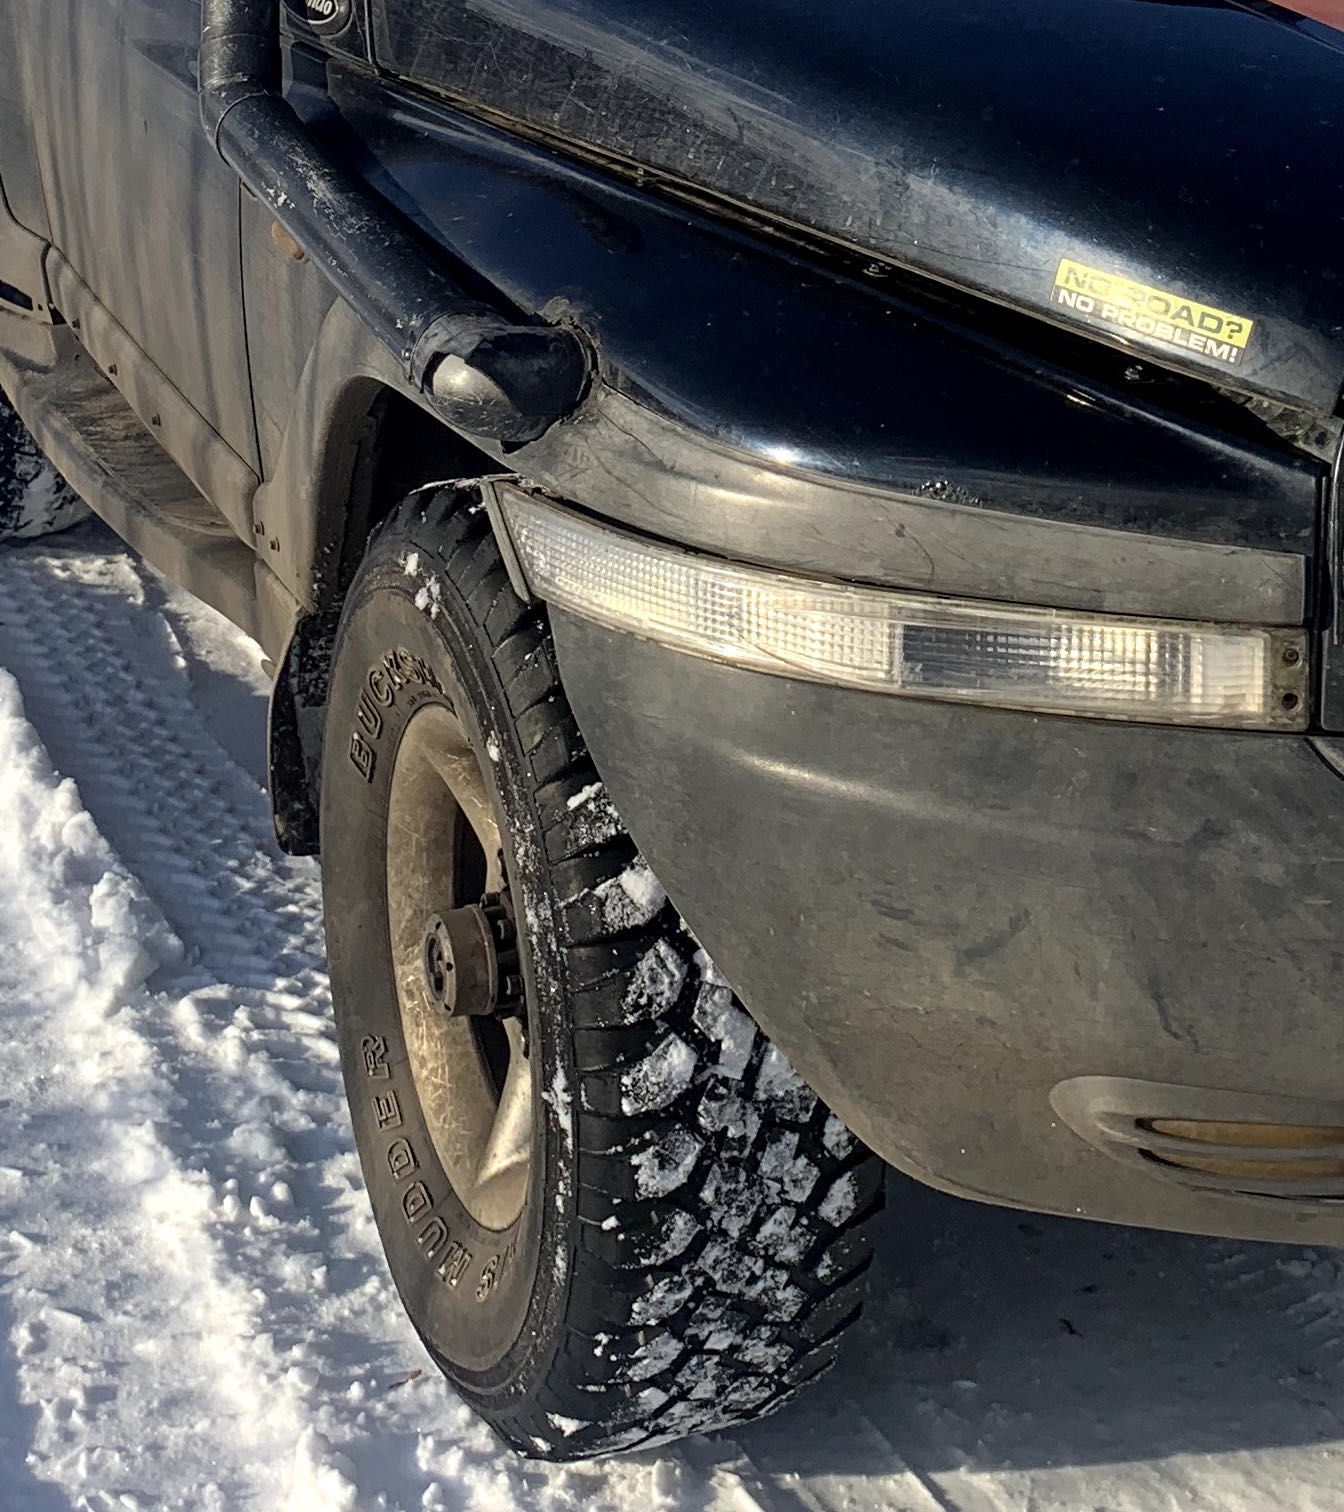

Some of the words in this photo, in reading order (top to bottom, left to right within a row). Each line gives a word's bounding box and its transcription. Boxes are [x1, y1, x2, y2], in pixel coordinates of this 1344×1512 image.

[1058, 289, 1094, 313] NO
[1101, 303, 1240, 364] PROBLEM!
[1063, 266, 1112, 296] NO
[1124, 285, 1244, 340] ROAD?
[360, 1033, 473, 1290] MUDDER
